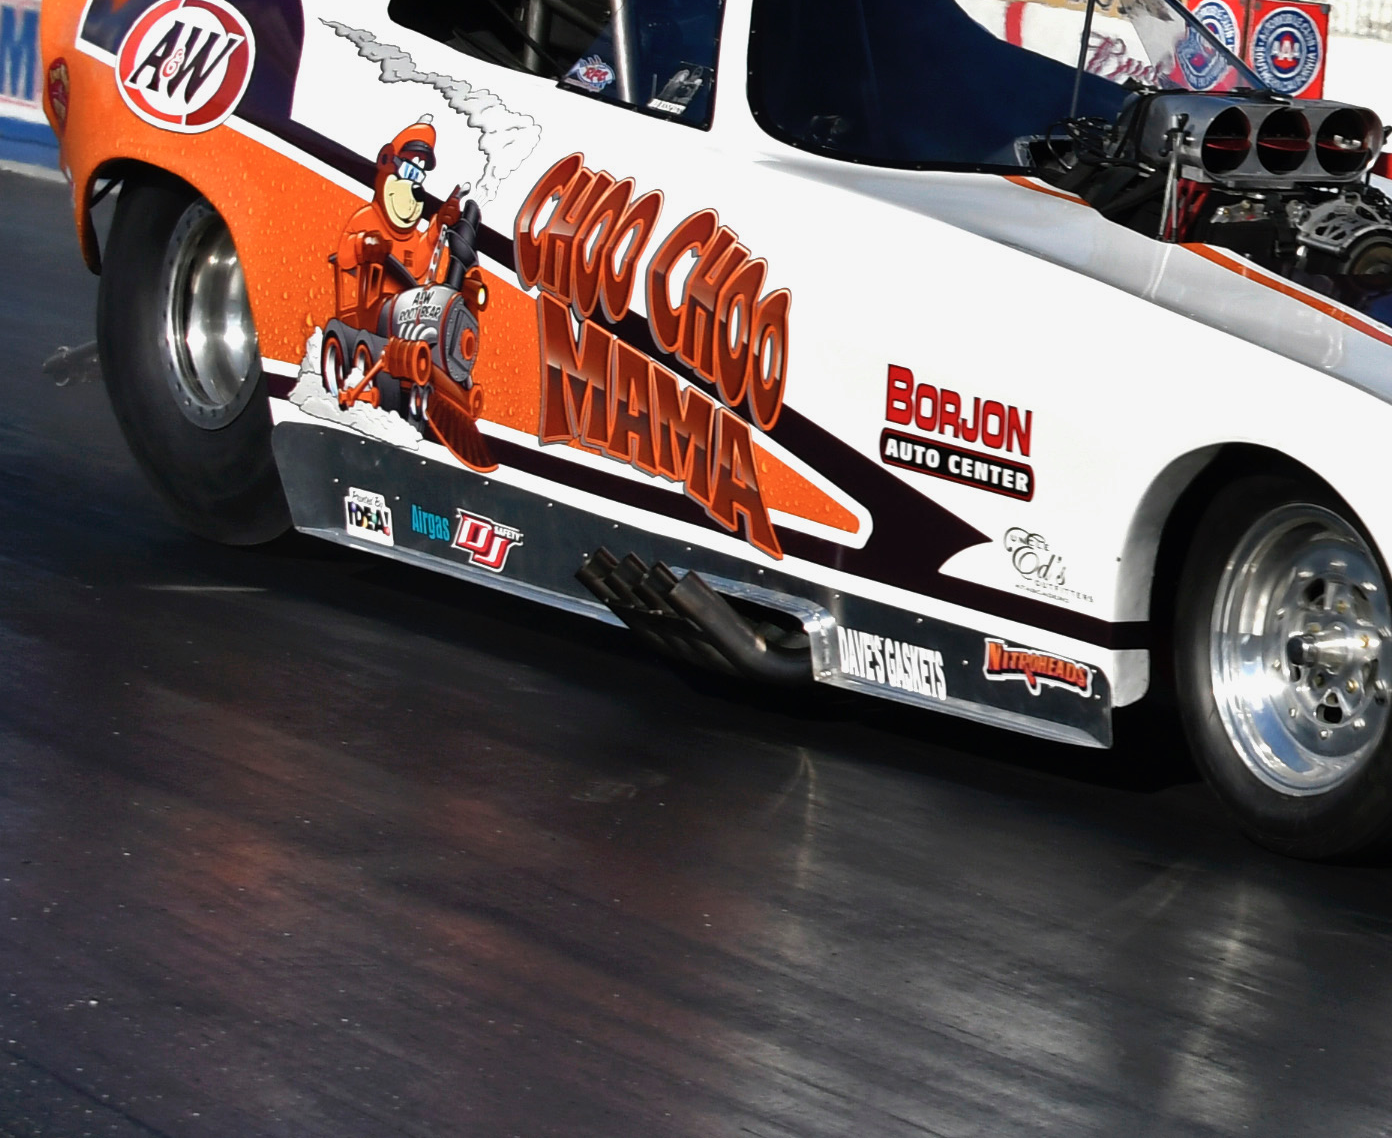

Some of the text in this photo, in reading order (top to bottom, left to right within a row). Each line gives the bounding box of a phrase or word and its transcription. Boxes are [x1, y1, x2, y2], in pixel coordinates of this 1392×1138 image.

[514, 151, 792, 432] CHOO CHOO
[537, 290, 784, 561] MAMA
[885, 364, 1033, 458] BORJON
[883, 438, 1031, 495] AUTO CENTER
[411, 503, 451, 542] Airgas
[457, 515, 521, 568] DJ SAFETY
[837, 625, 947, 700] DAVE'S GASKETS
